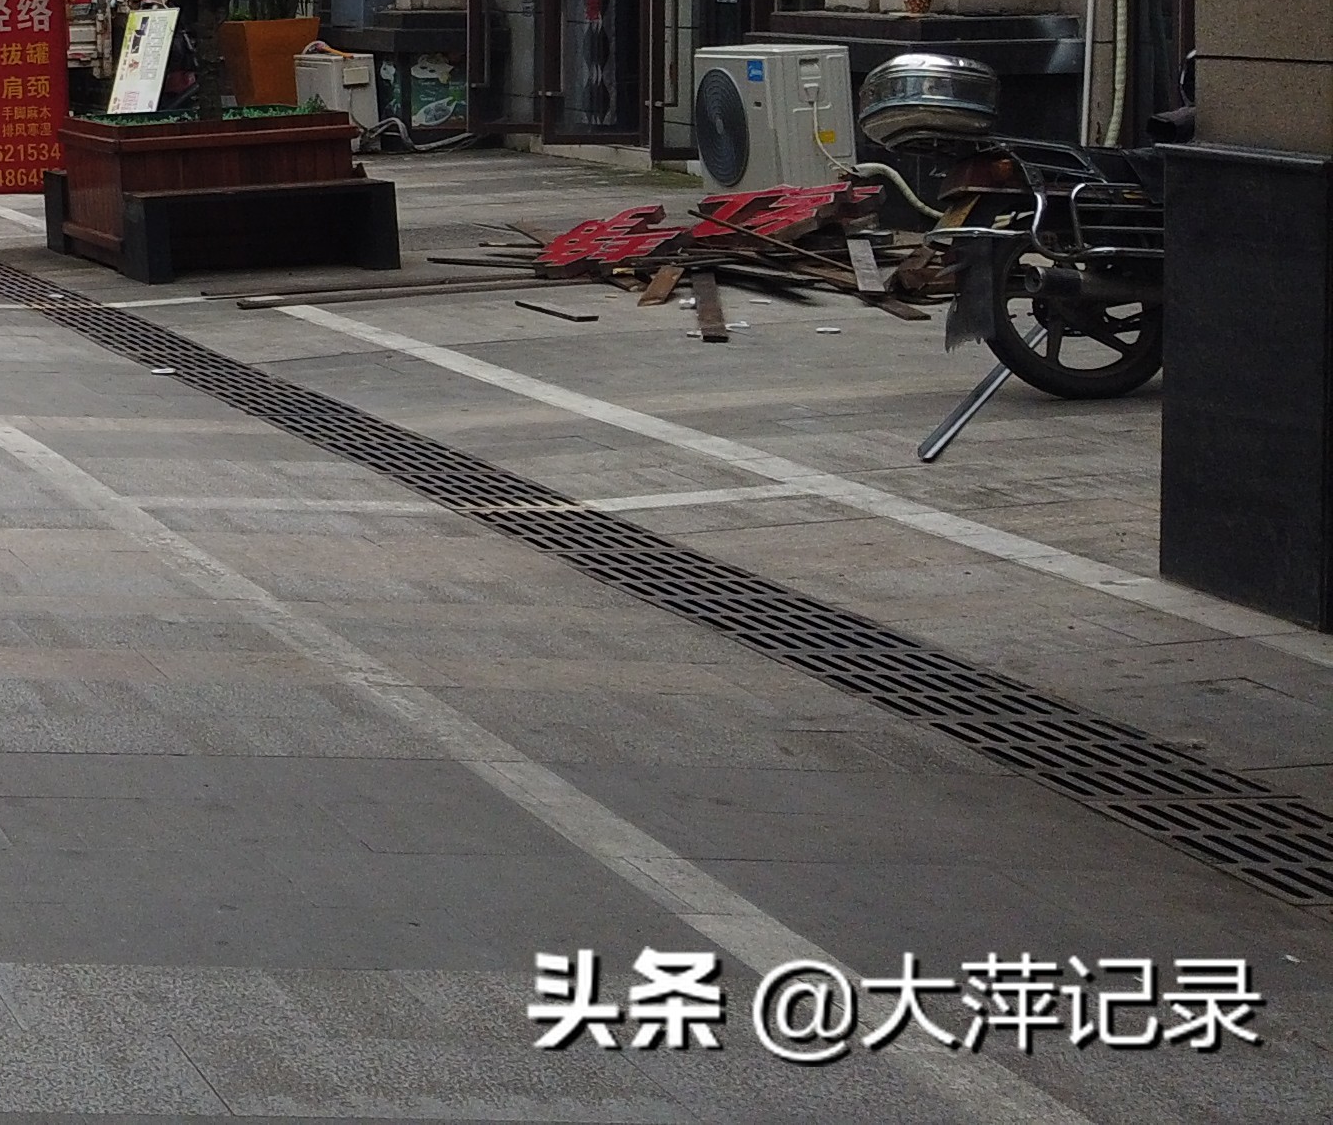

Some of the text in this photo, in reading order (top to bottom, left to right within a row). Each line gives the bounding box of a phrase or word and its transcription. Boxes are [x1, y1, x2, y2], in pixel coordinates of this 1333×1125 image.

[0, 41, 50, 66] 拔罐
[2, 75, 51, 100] 肩颈
[1, 106, 52, 121] 手脚麻木
